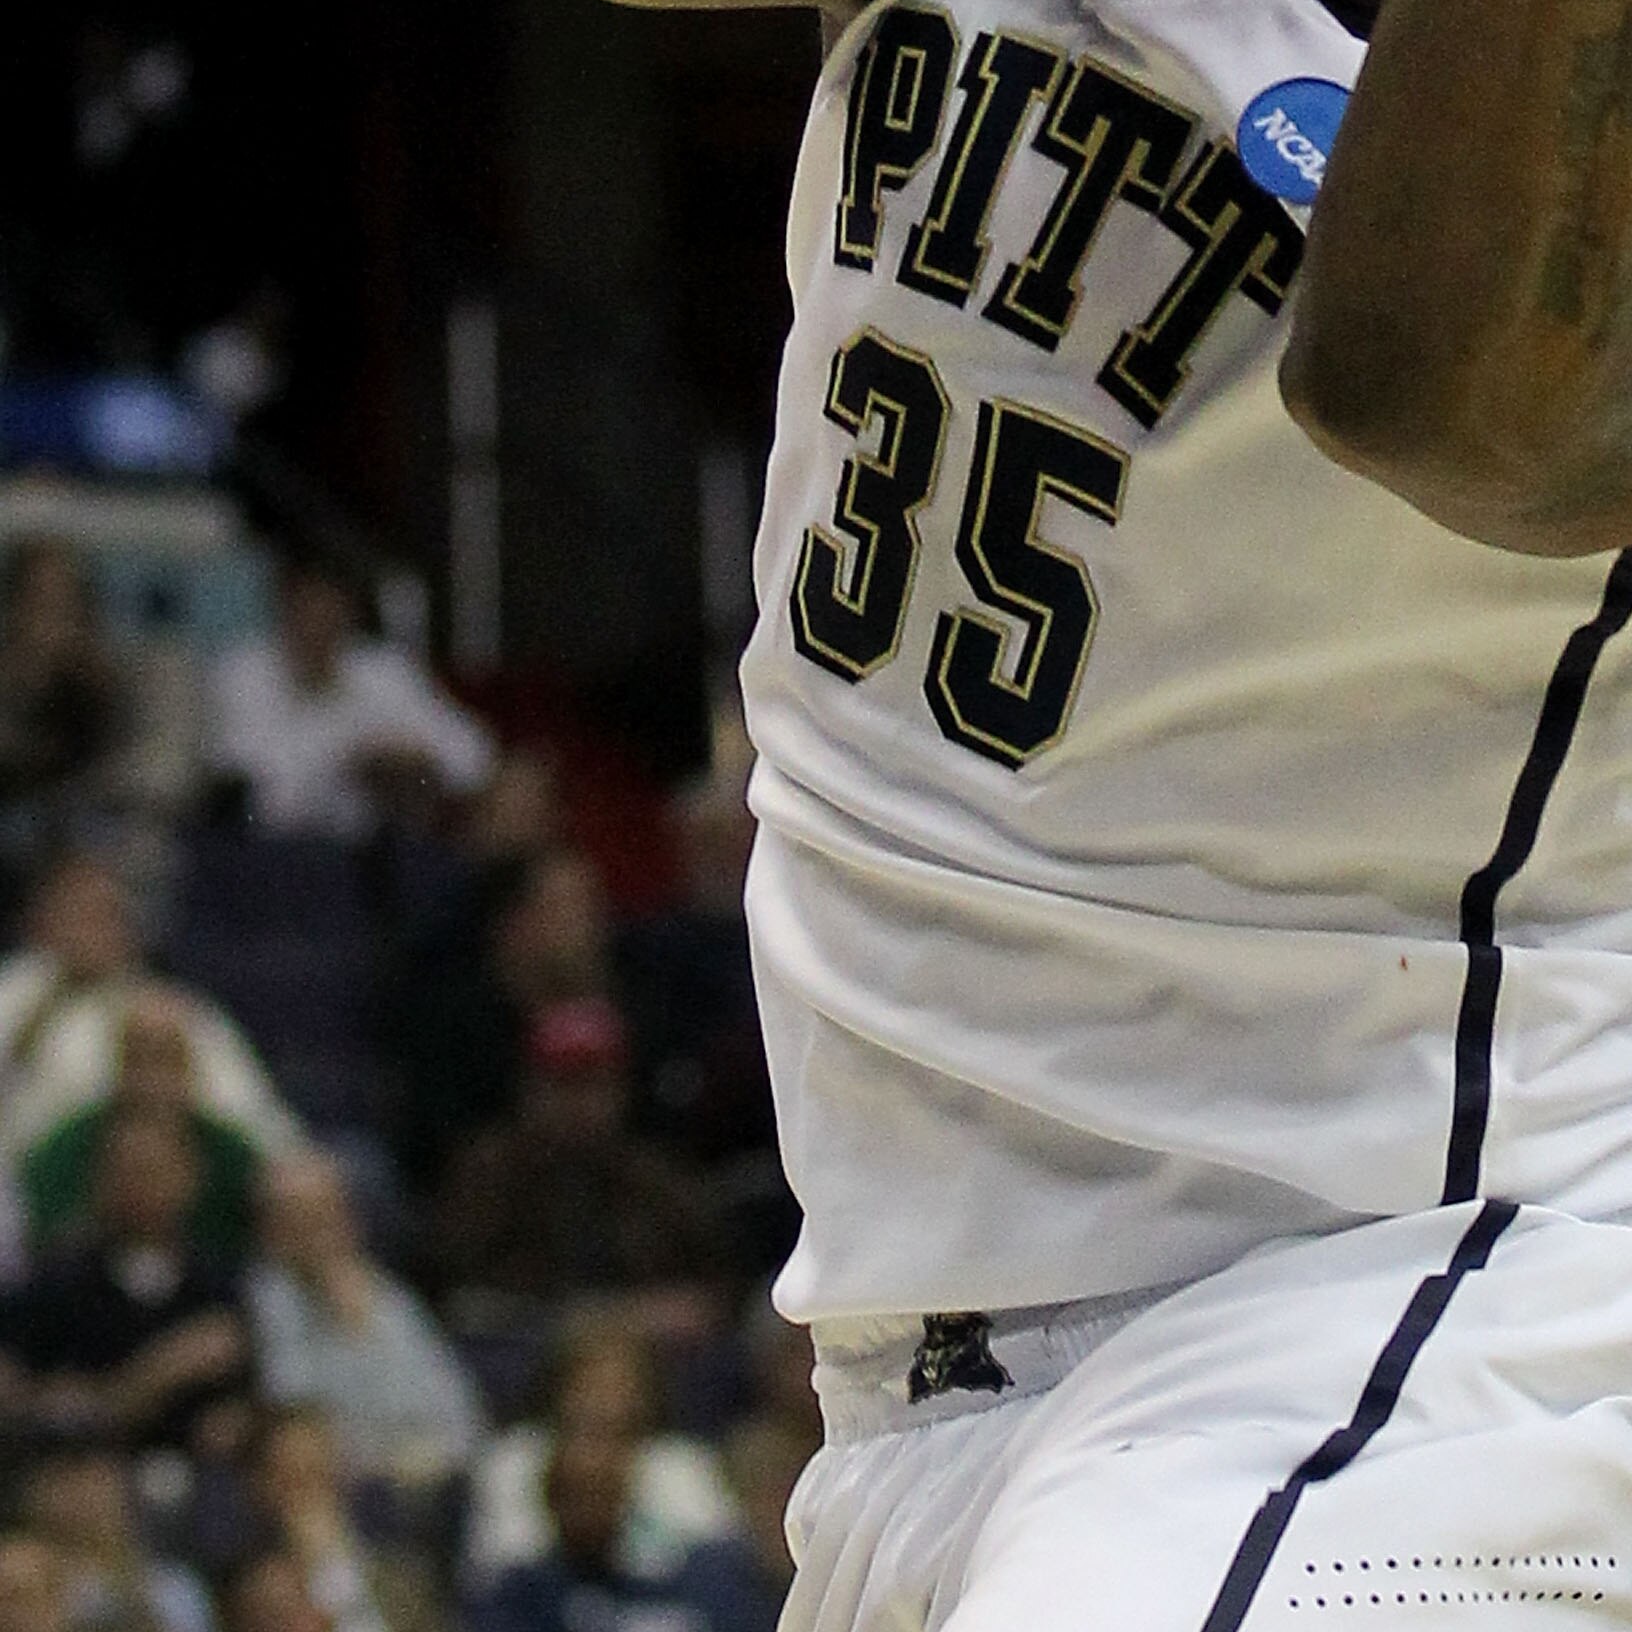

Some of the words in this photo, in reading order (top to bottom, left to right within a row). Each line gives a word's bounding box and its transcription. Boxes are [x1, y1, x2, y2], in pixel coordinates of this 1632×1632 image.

[832, 5, 1306, 431] PITT
[1252, 106, 1328, 191] NCA
[789, 324, 1132, 772] 35
